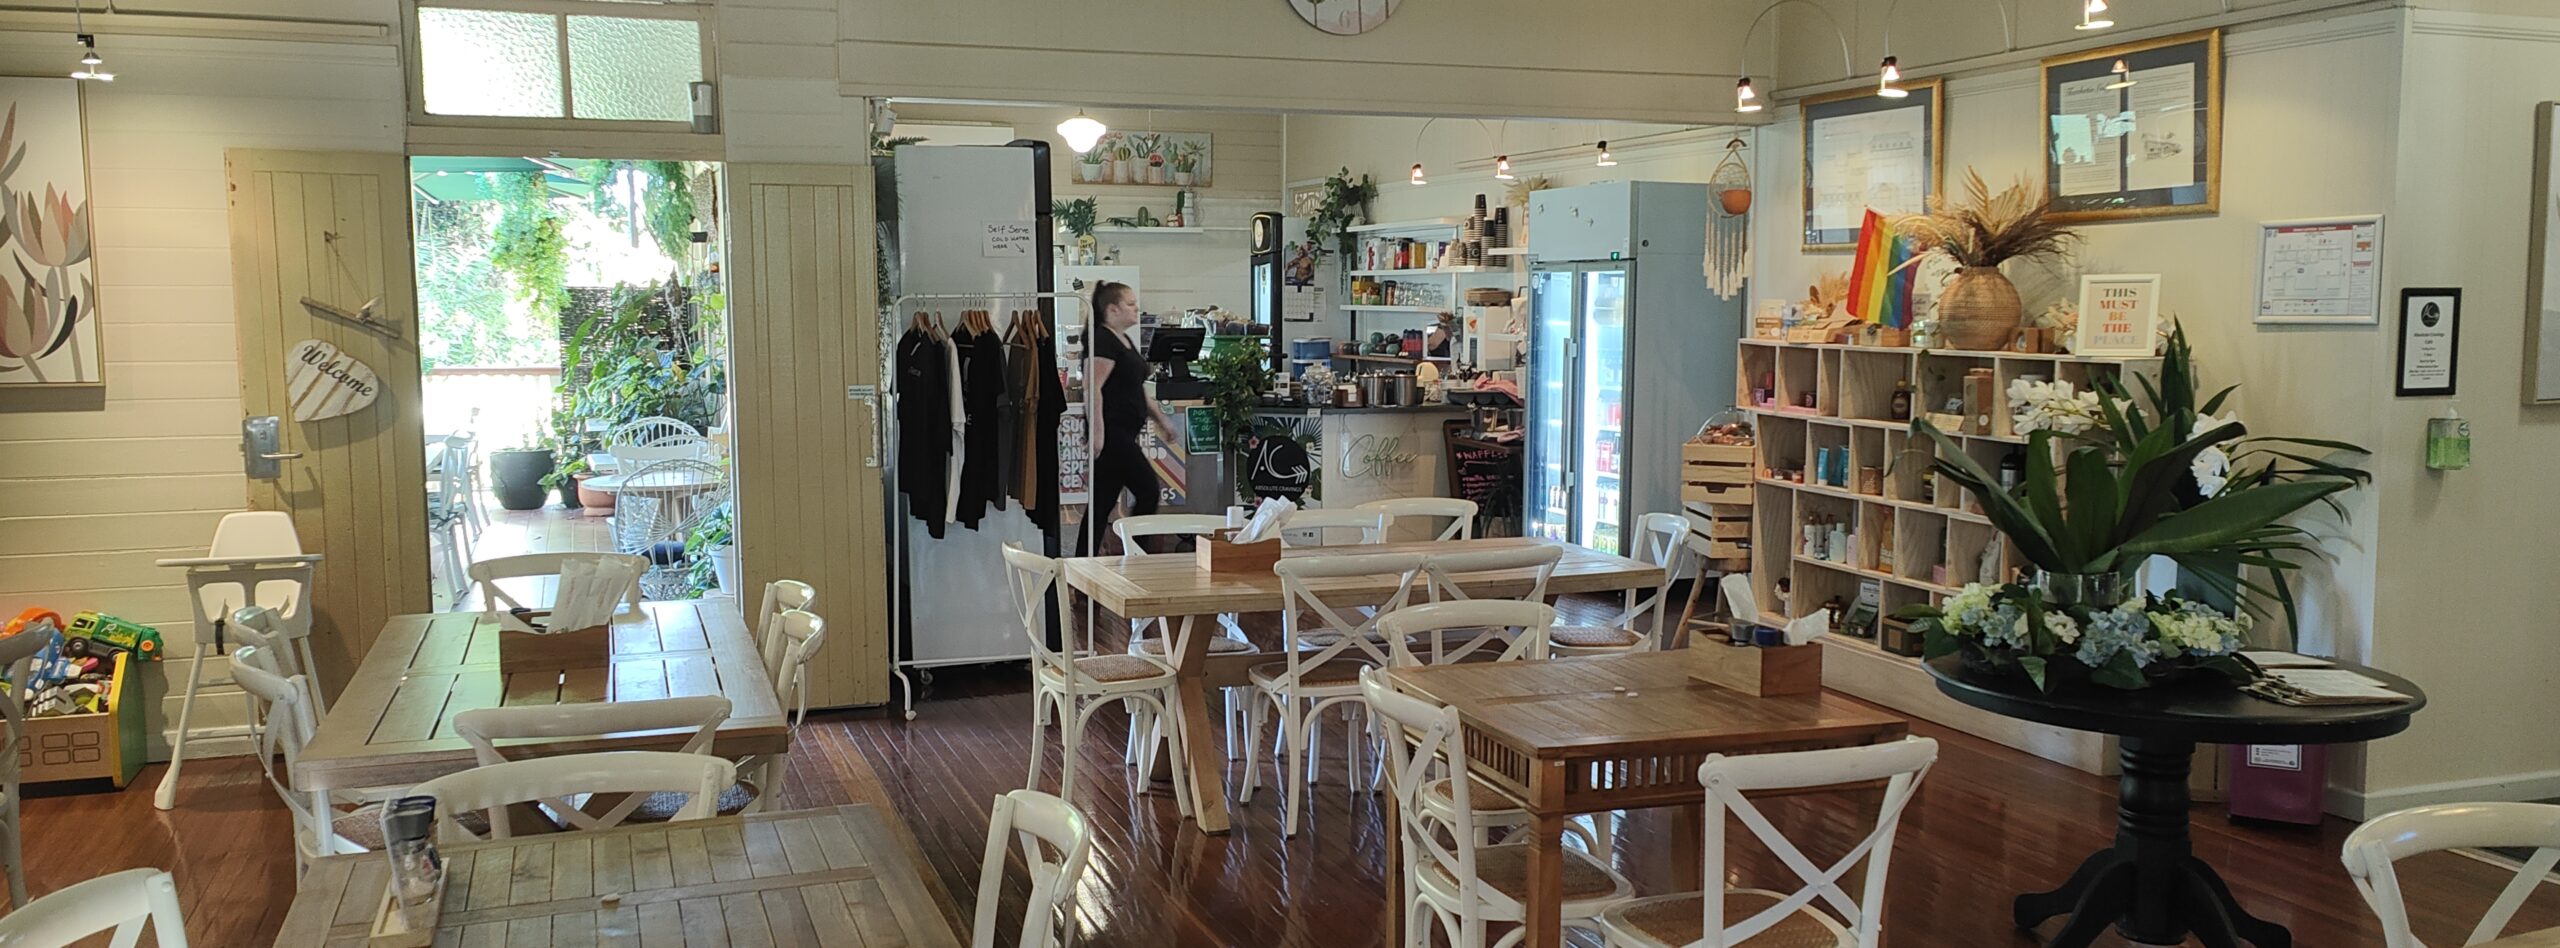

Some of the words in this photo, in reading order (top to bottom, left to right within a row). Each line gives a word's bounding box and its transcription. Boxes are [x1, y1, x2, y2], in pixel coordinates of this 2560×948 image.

[988, 224, 1006, 234] Self
[1008, 224, 1029, 233] Serve
[2103, 288, 2137, 297] THIS
[2100, 300, 2137, 309] MUST
[2108, 311, 2127, 320] BE
[2103, 323, 2132, 333] THE
[2093, 335, 2138, 345] PLACE
[301, 345, 373, 397] Welcome
[1138, 433, 1156, 446] HE
[1141, 446, 1168, 460] OOD
[1342, 433, 1418, 479] Coffee
[1160, 488, 1176, 500] GS
